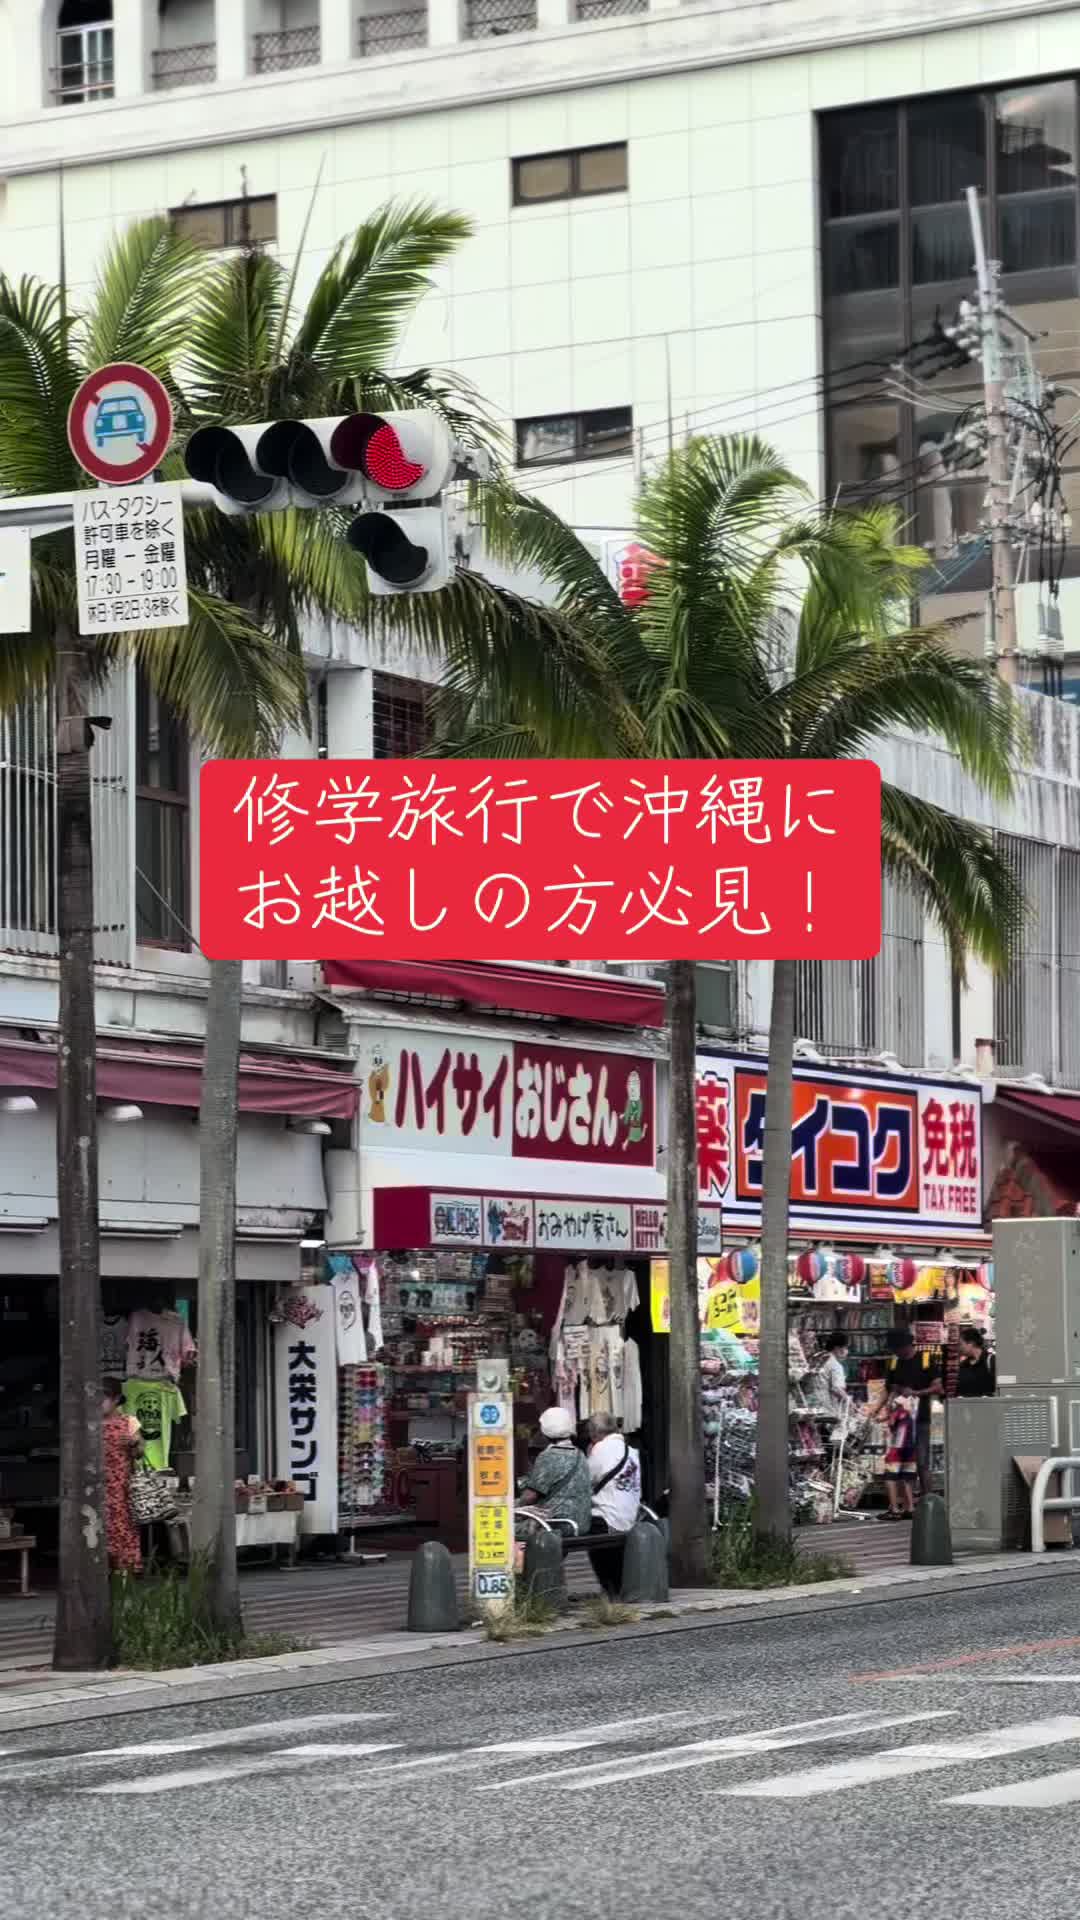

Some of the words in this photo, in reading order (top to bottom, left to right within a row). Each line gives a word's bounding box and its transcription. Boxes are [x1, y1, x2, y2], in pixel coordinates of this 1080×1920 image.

[83, 517, 176, 546] 許可車を除く
[922, 1097, 977, 1179] 免税
[924, 1183, 946, 1210] TAX
[949, 1185, 977, 1213] FREE
[538, 1209, 628, 1242] おみやげ家さん
[287, 1340, 319, 1502] 大栄サンゴ
